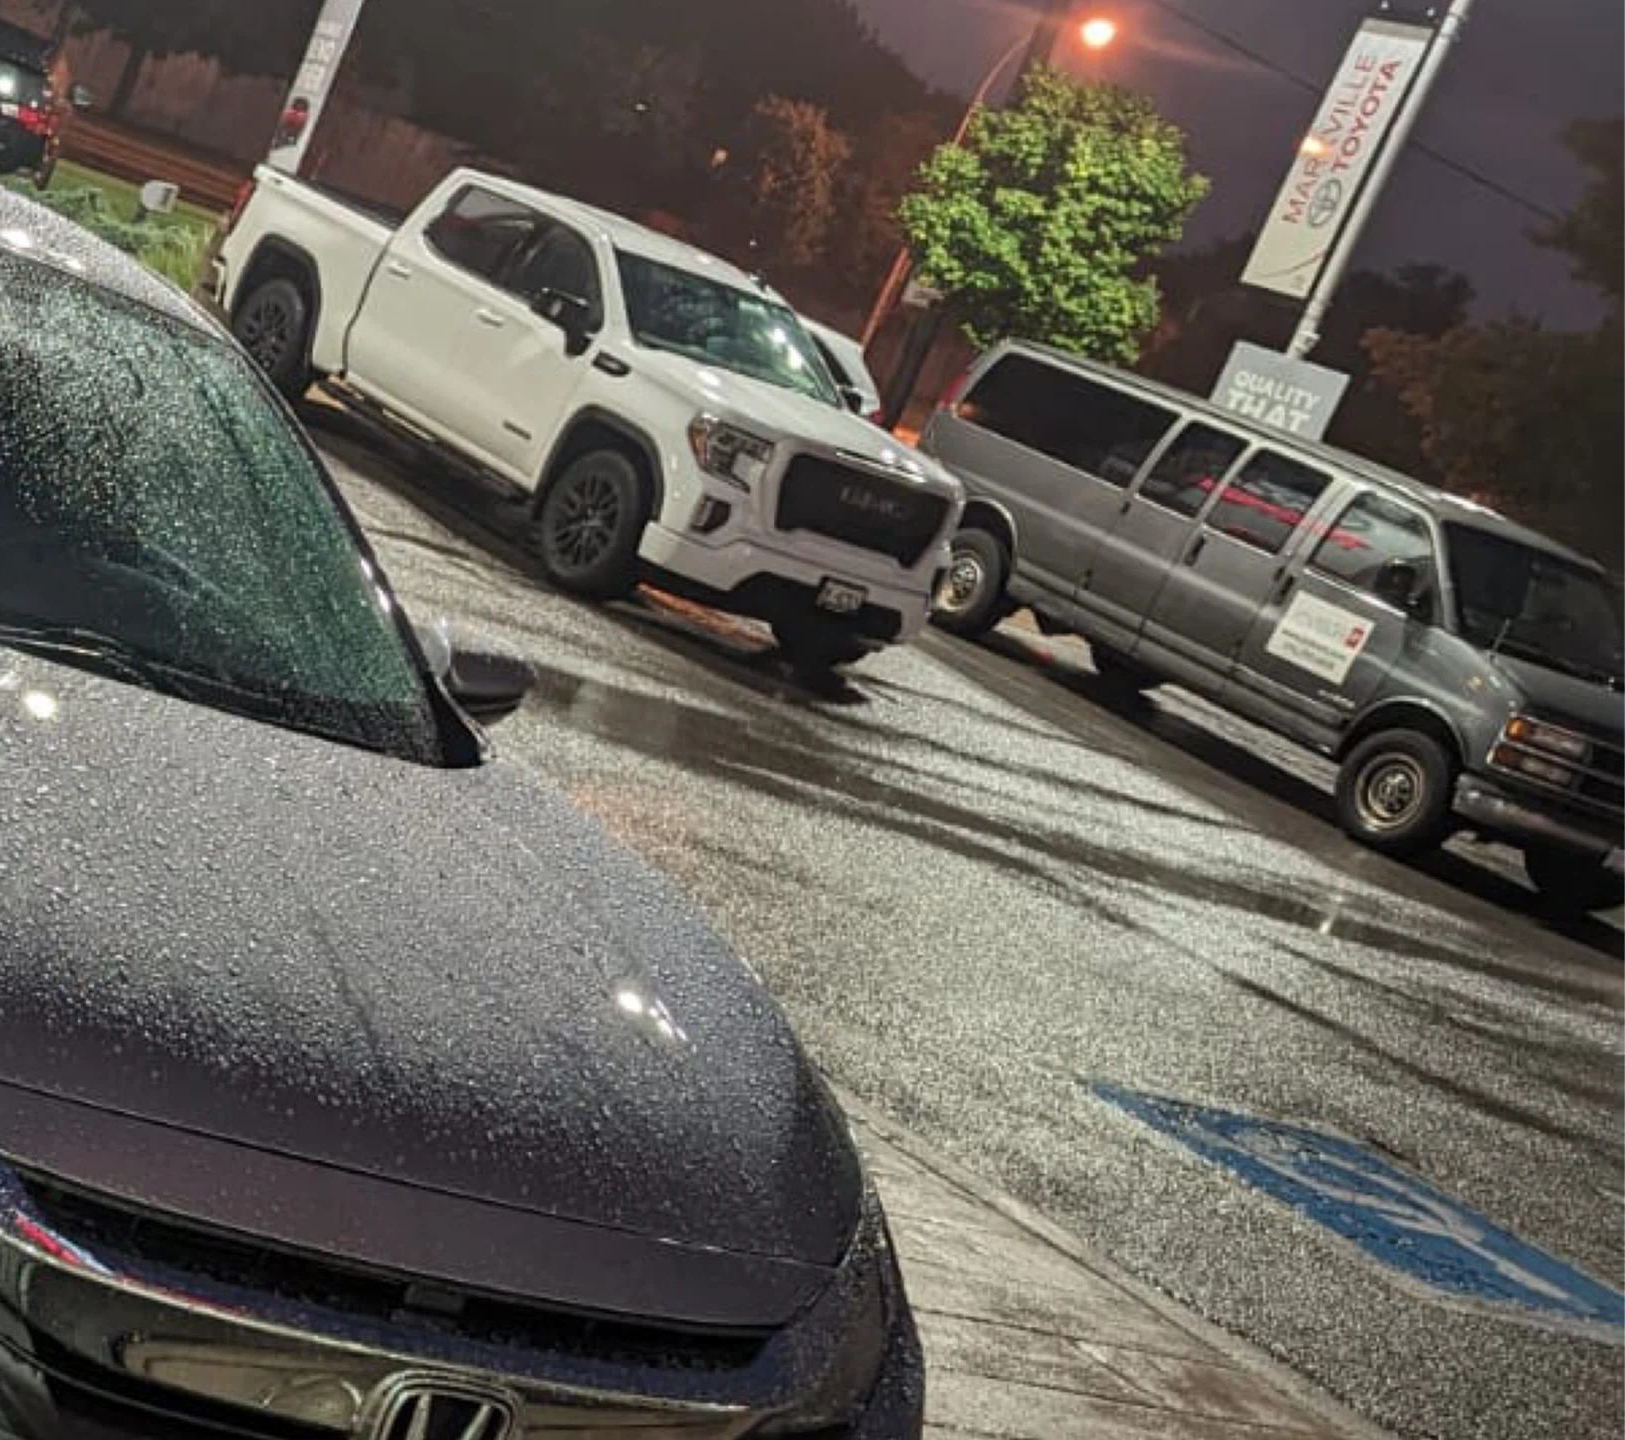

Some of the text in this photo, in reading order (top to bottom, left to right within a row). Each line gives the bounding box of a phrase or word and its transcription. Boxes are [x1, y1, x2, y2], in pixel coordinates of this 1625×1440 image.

[1282, 55, 1374, 224] MARVILLE
[1331, 60, 1401, 173] TOYOTA
[1227, 388, 1311, 432] THAT
[1235, 371, 1321, 410] QUALITY
